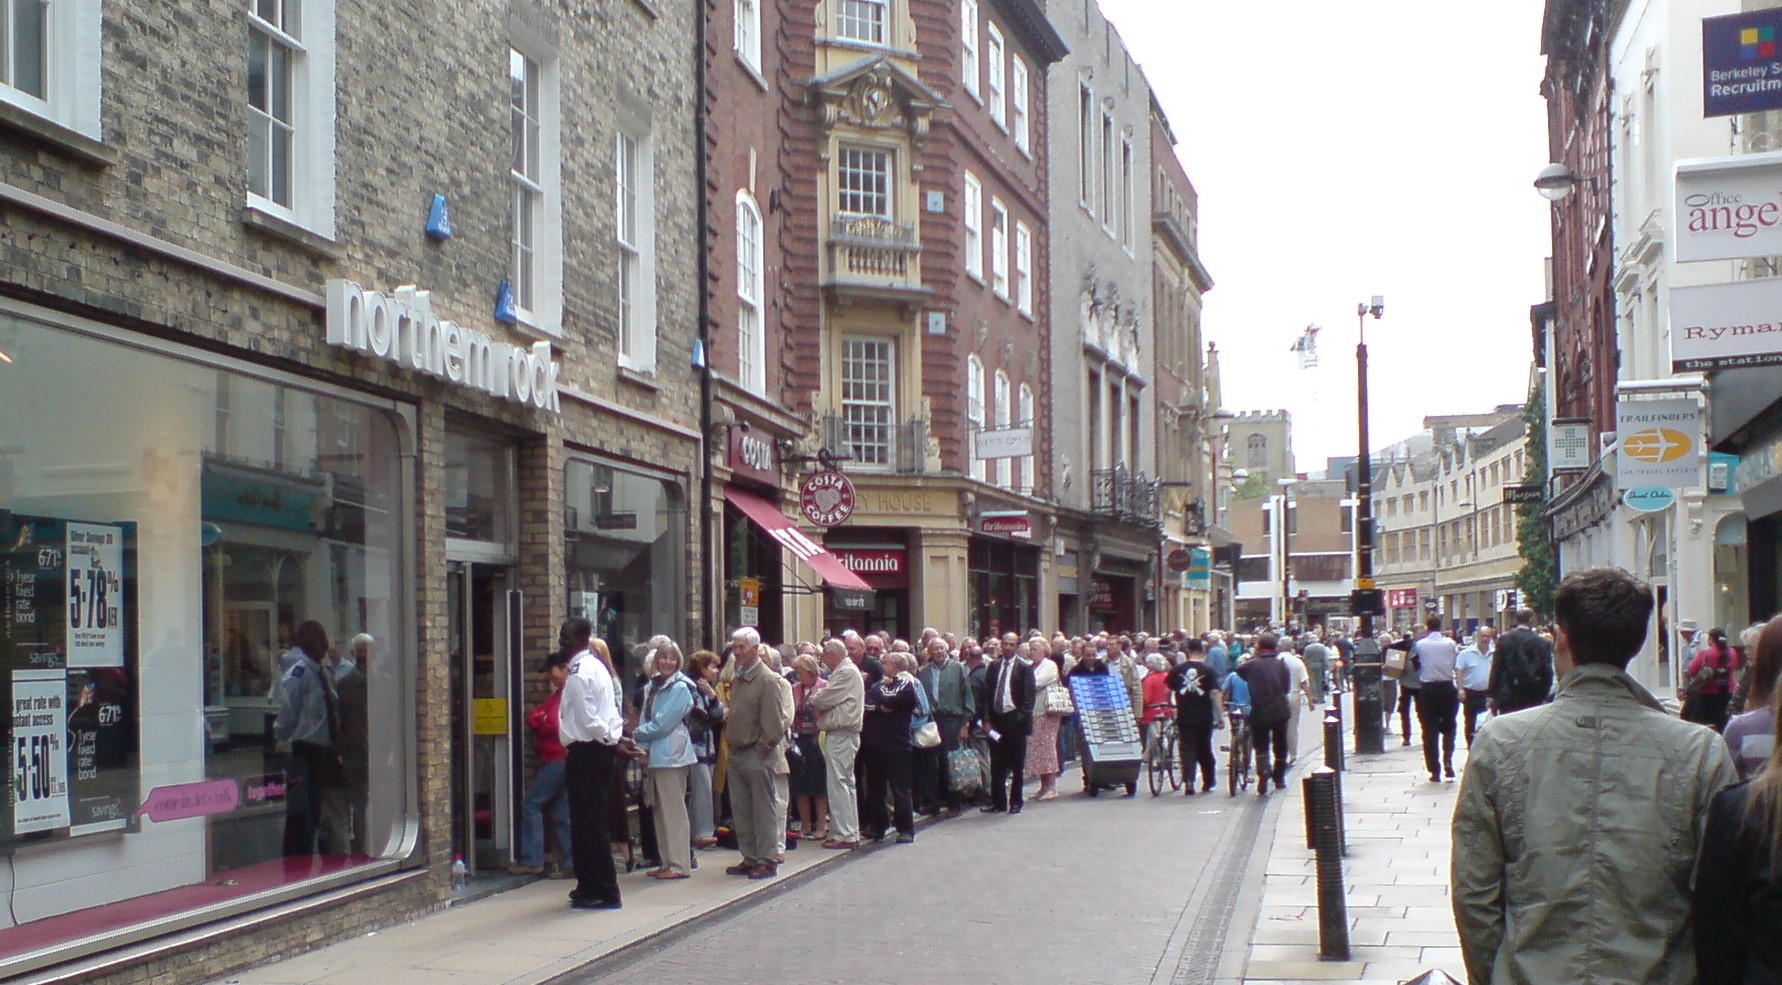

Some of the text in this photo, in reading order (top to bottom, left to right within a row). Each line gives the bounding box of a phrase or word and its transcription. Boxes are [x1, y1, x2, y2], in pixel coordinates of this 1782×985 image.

[1711, 65, 1768, 82] Berkeley
[1685, 192, 1743, 207] Office
[326, 279, 493, 389] northern
[1685, 360, 1714, 369] the
[1620, 412, 1696, 424] TRAILFINDERS
[742, 435, 773, 471] COSTA
[807, 475, 844, 492] COSTA
[878, 493, 931, 513] HOUSE
[806, 503, 849, 523] COFFEE
[832, 552, 899, 572] ritannia
[20, 572, 37, 584] year
[15, 582, 35, 598] fixed
[15, 599, 31, 610] rate
[15, 610, 36, 623] bond
[29, 652, 60, 668] savings
[33, 696, 47, 710] rate
[32, 713, 54, 726] access
[82, 731, 98, 744] year
[78, 740, 96, 755] fixed
[78, 756, 92, 767] rate
[78, 766, 97, 780] bond
